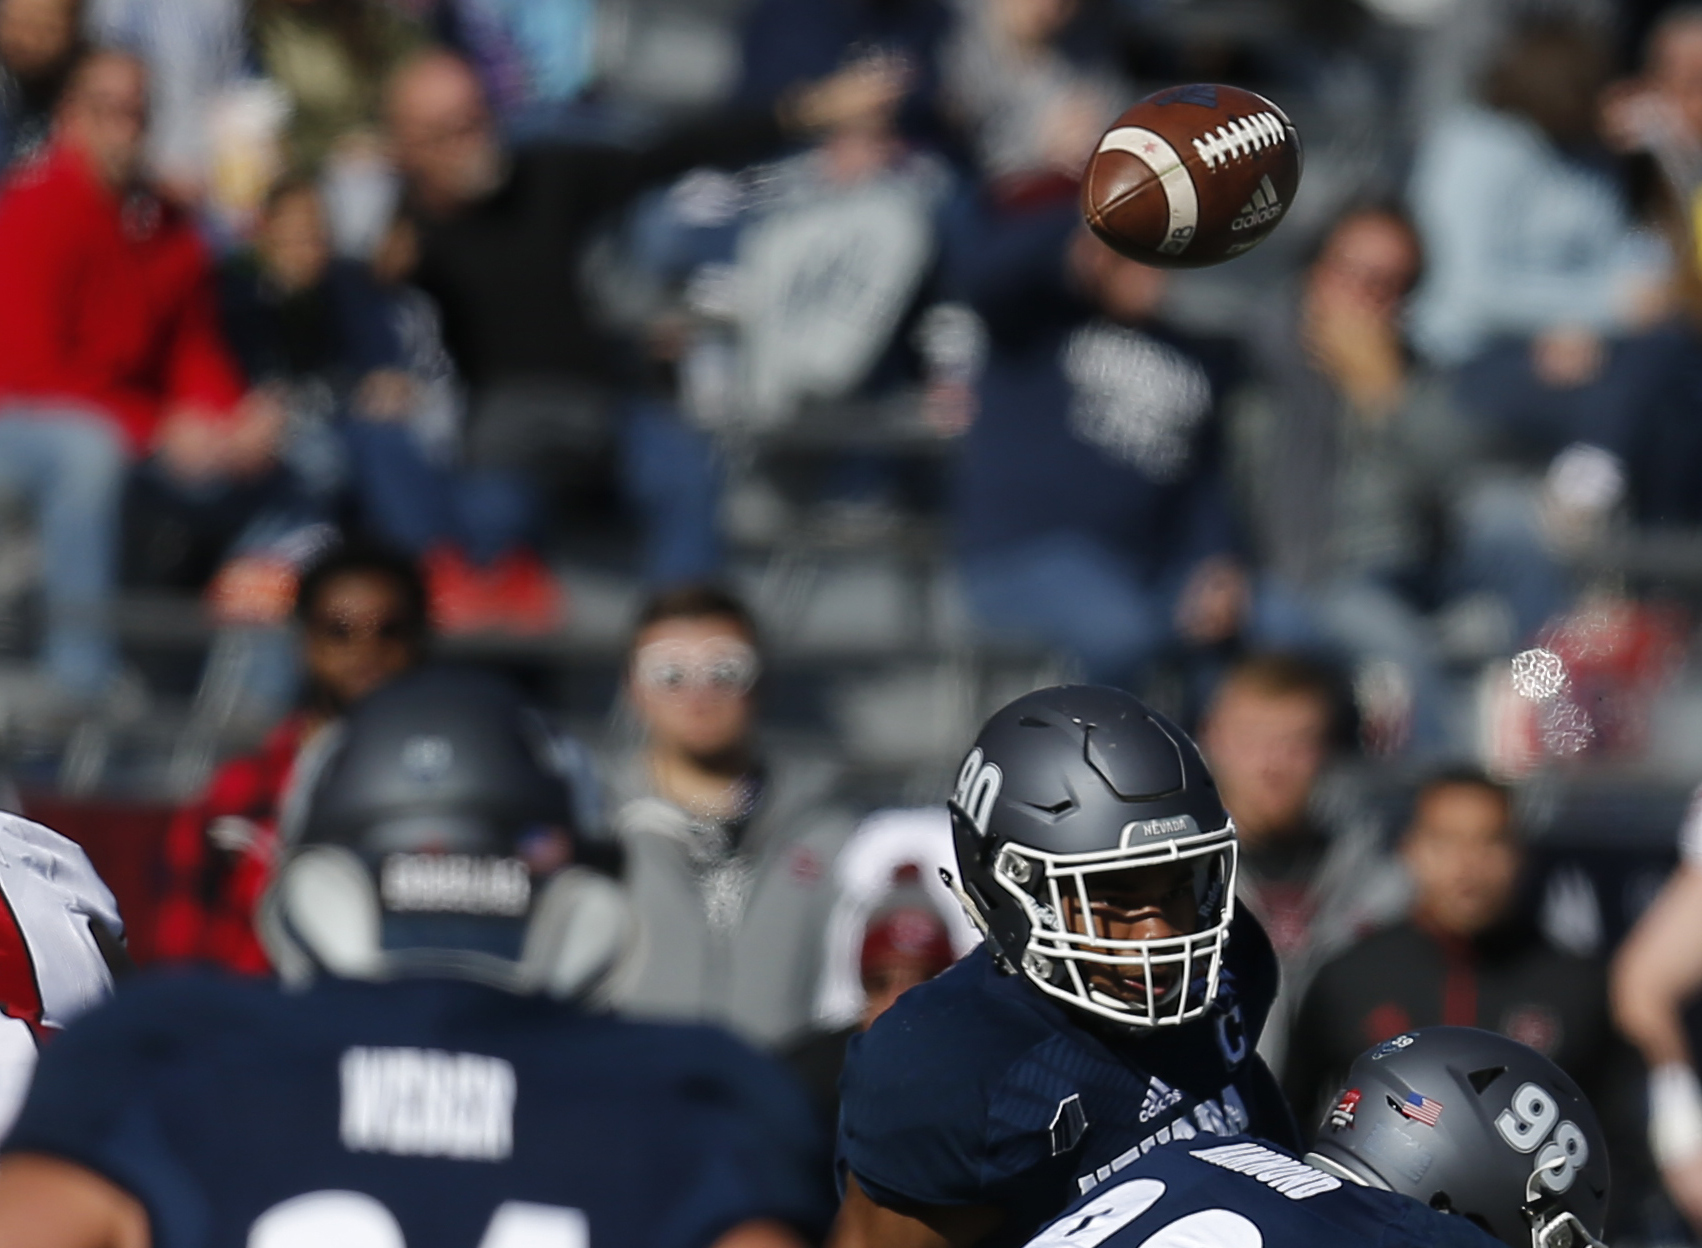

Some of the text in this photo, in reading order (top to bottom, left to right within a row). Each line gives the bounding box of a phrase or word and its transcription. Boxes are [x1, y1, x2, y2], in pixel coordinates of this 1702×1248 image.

[953, 746, 1003, 836] 90
[1143, 818, 1188, 837] NEVADA
[1494, 1081, 1590, 1195] 98
